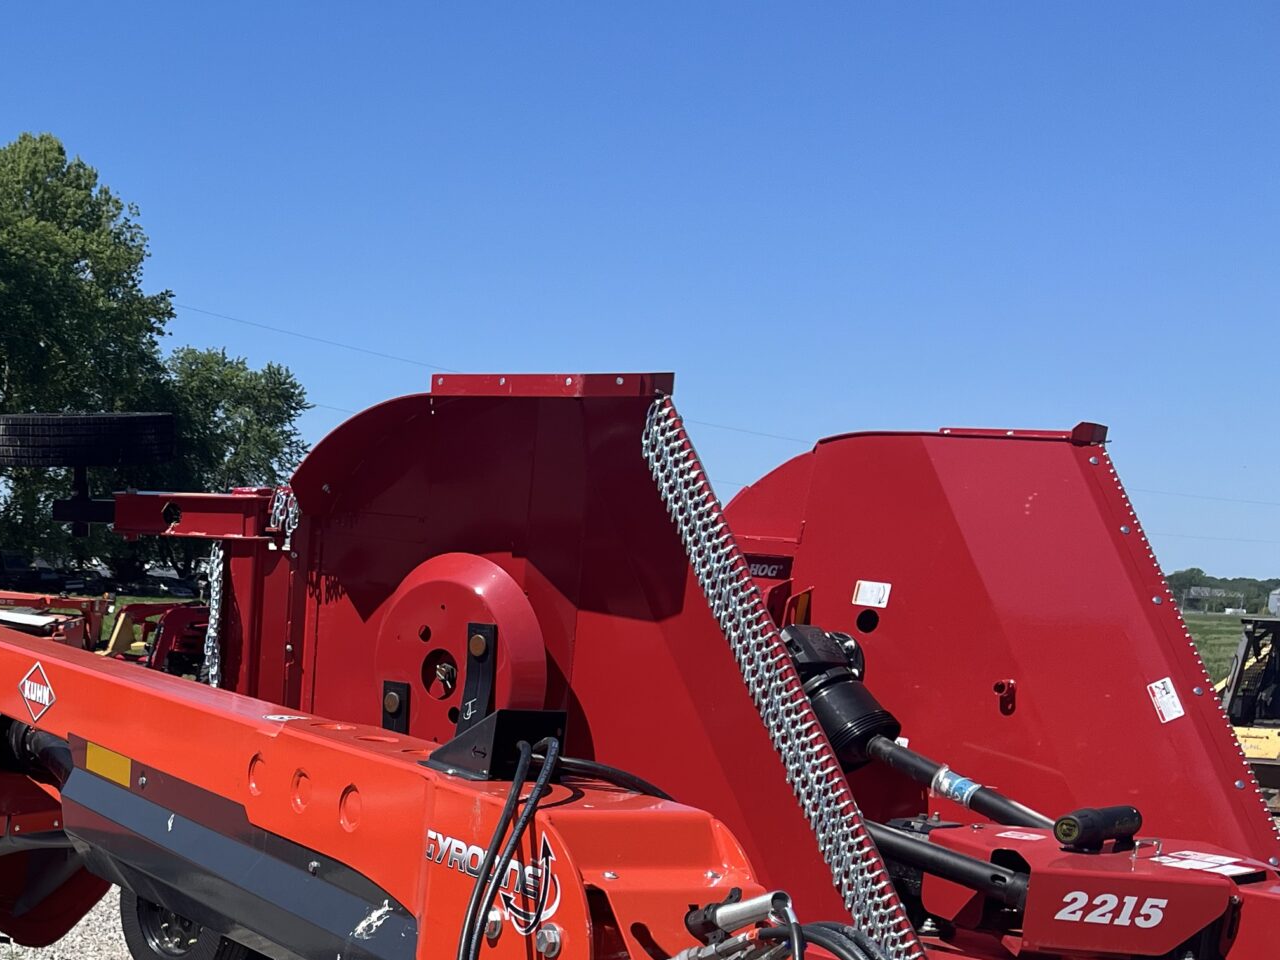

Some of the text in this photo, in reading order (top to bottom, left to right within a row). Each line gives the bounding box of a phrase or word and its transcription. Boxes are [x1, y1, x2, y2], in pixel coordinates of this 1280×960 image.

[24, 679, 50, 706] KUHN
[425, 829, 542, 899] GYRONE
[1054, 891, 1169, 929] 2215
